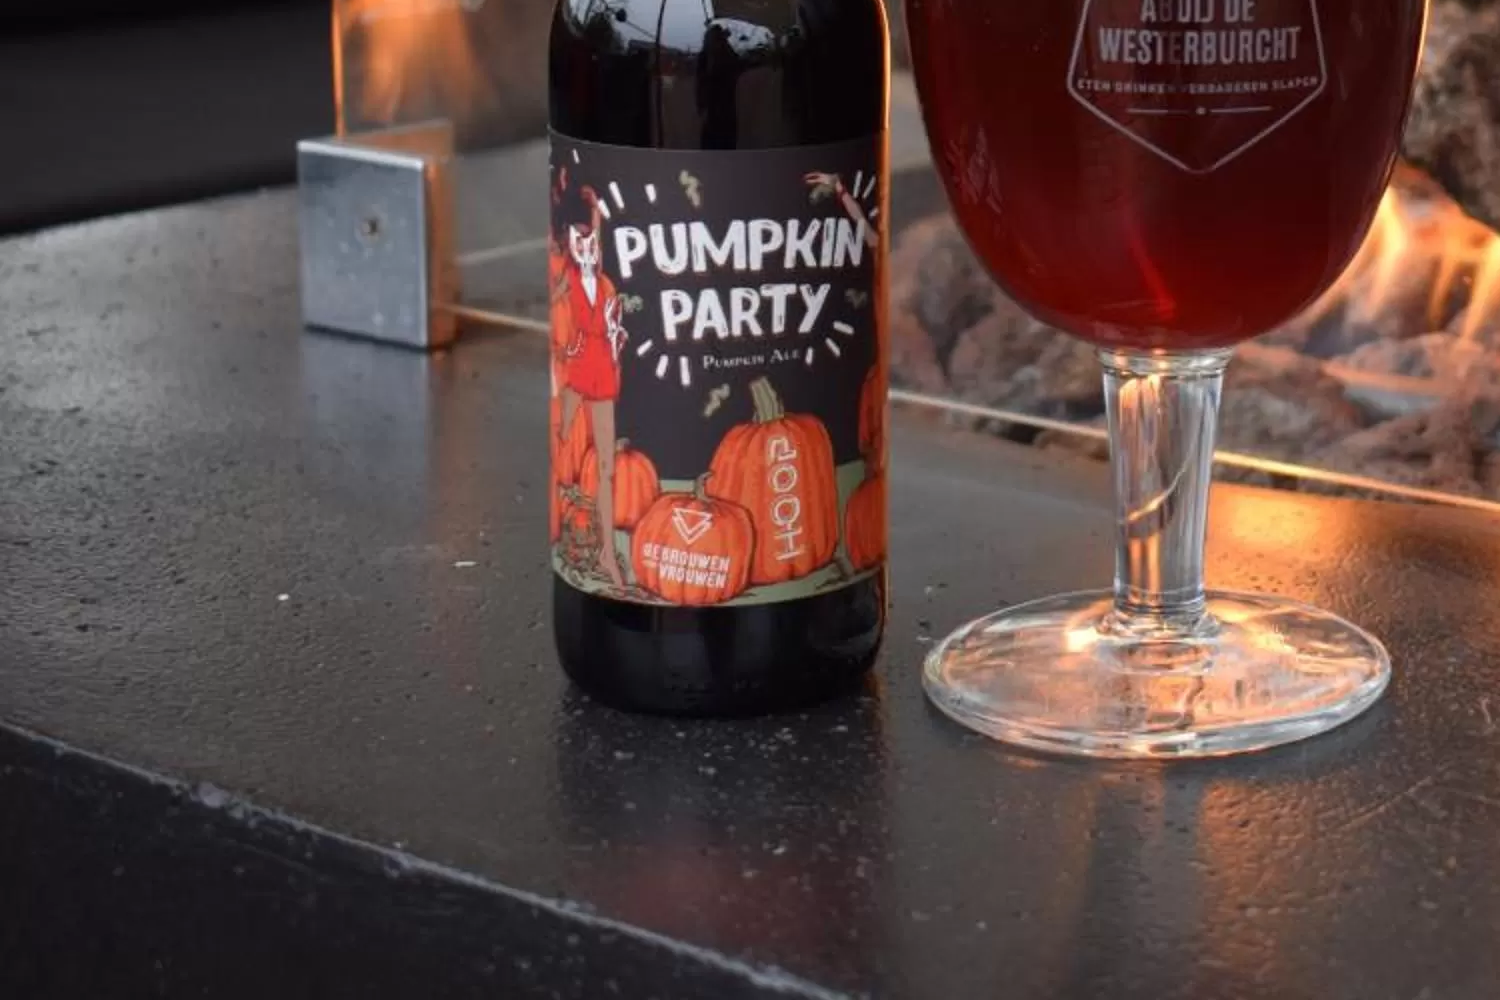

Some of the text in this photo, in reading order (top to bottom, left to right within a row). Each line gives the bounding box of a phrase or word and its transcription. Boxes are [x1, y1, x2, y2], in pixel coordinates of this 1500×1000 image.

[1098, 26, 1300, 65] WESTERBURCHT
[613, 217, 866, 278] PUMPKIN
[660, 283, 832, 341] PARTY
